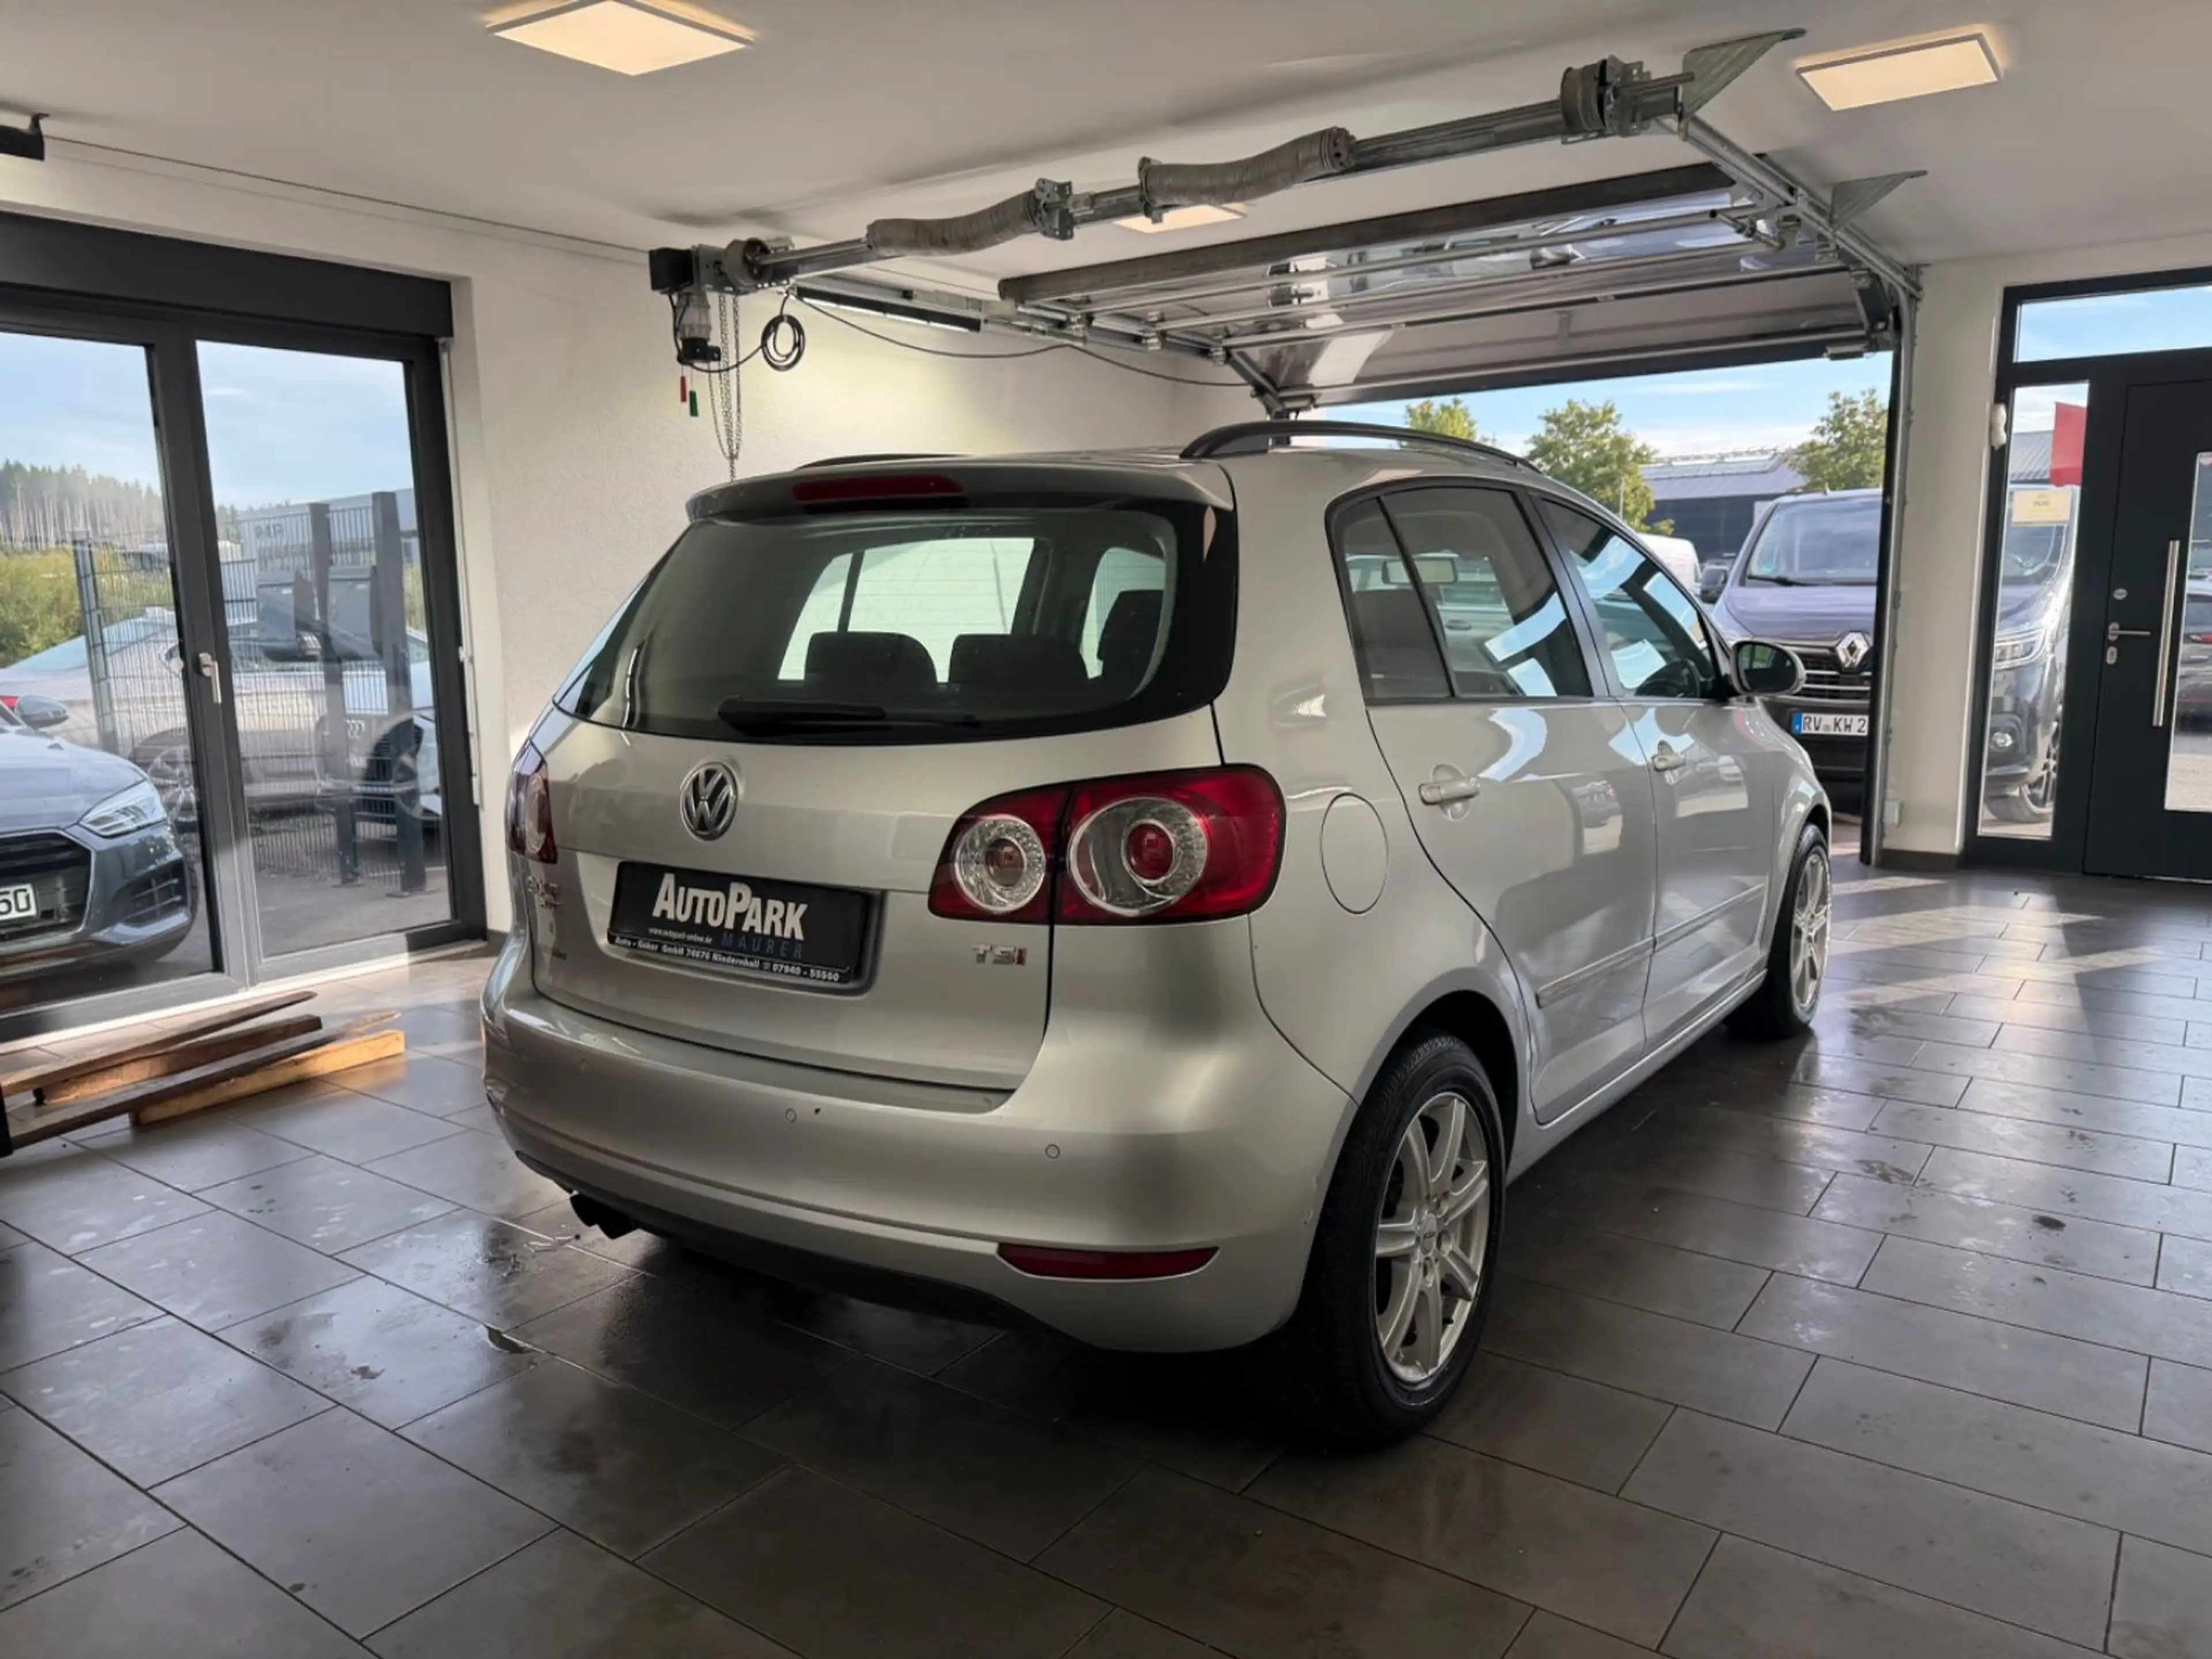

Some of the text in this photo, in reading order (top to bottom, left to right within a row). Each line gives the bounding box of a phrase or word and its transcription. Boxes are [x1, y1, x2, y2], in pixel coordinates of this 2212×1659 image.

[1804, 715, 1822, 731] RV
[1833, 717, 1853, 733] KW
[721, 930, 802, 959] MAURER
[972, 944, 1027, 966] TSI
